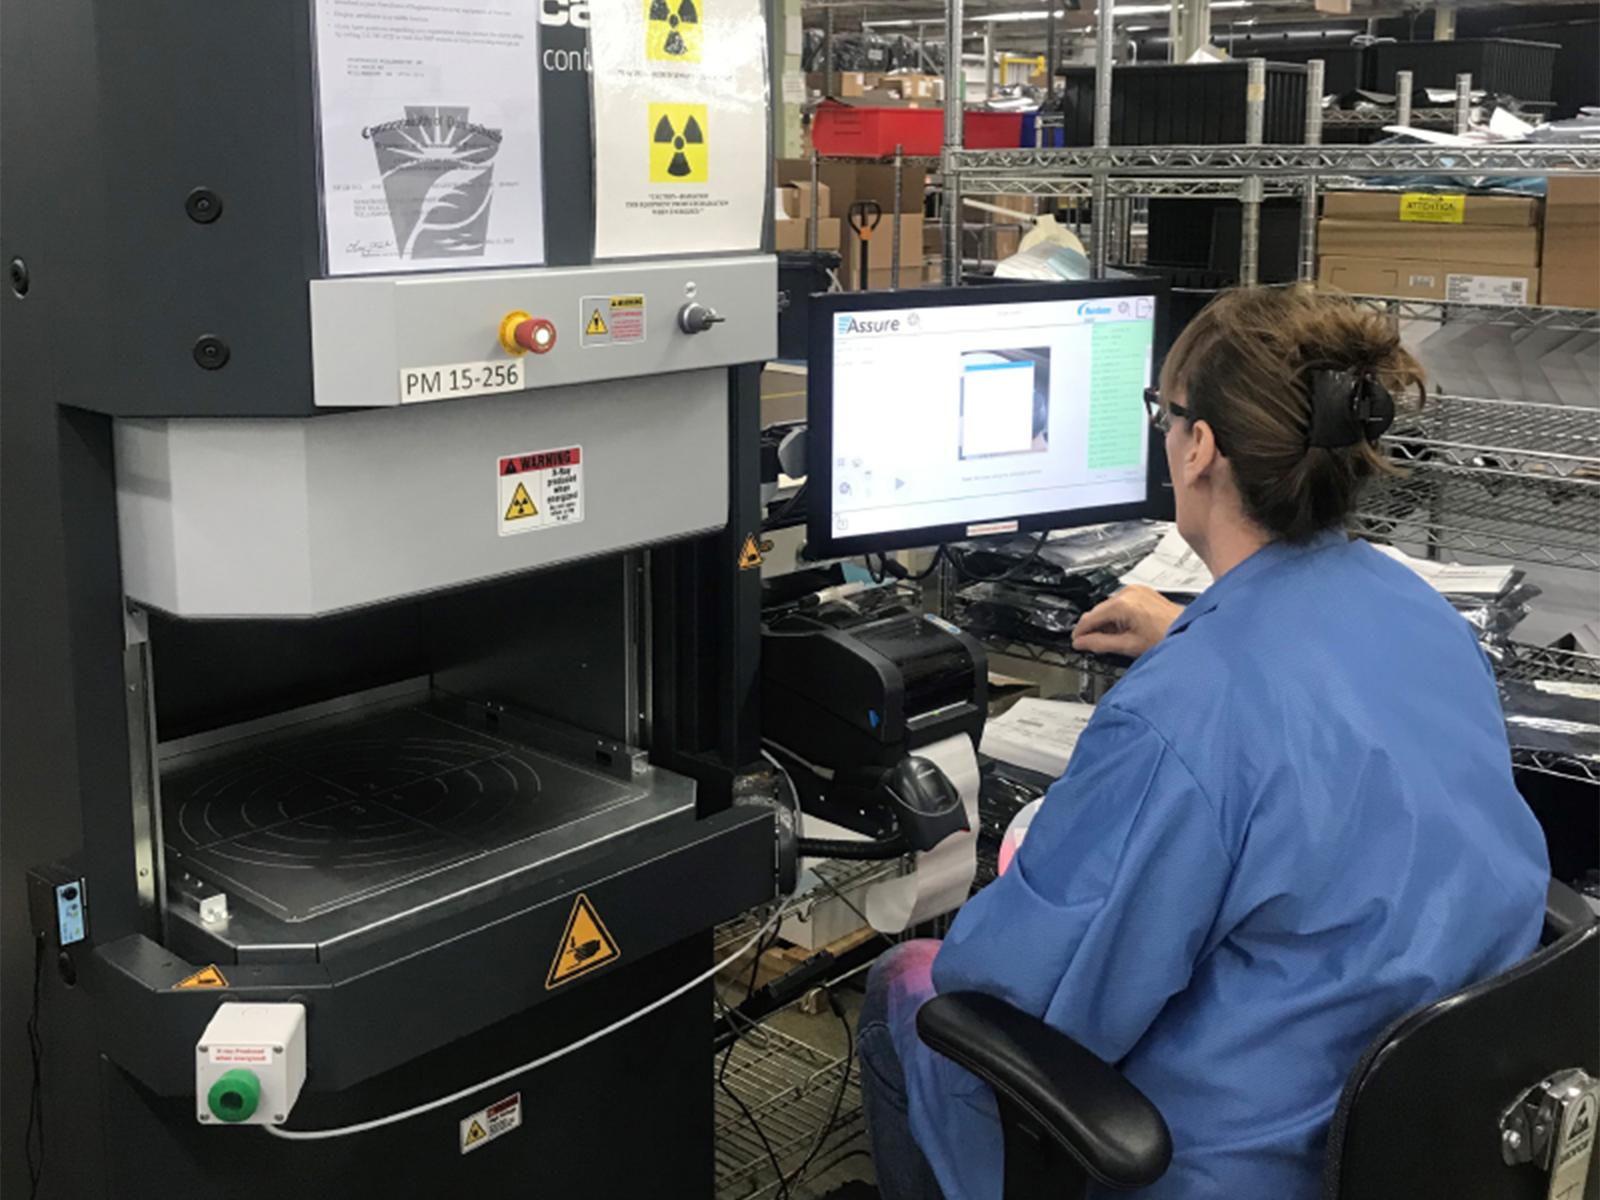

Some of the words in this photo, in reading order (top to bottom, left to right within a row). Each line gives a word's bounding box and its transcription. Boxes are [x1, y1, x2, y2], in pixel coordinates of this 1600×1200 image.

[847, 316, 900, 334] Assure
[406, 371, 441, 395] PM
[449, 363, 519, 391] 15-256
[521, 449, 571, 471] WARNING
